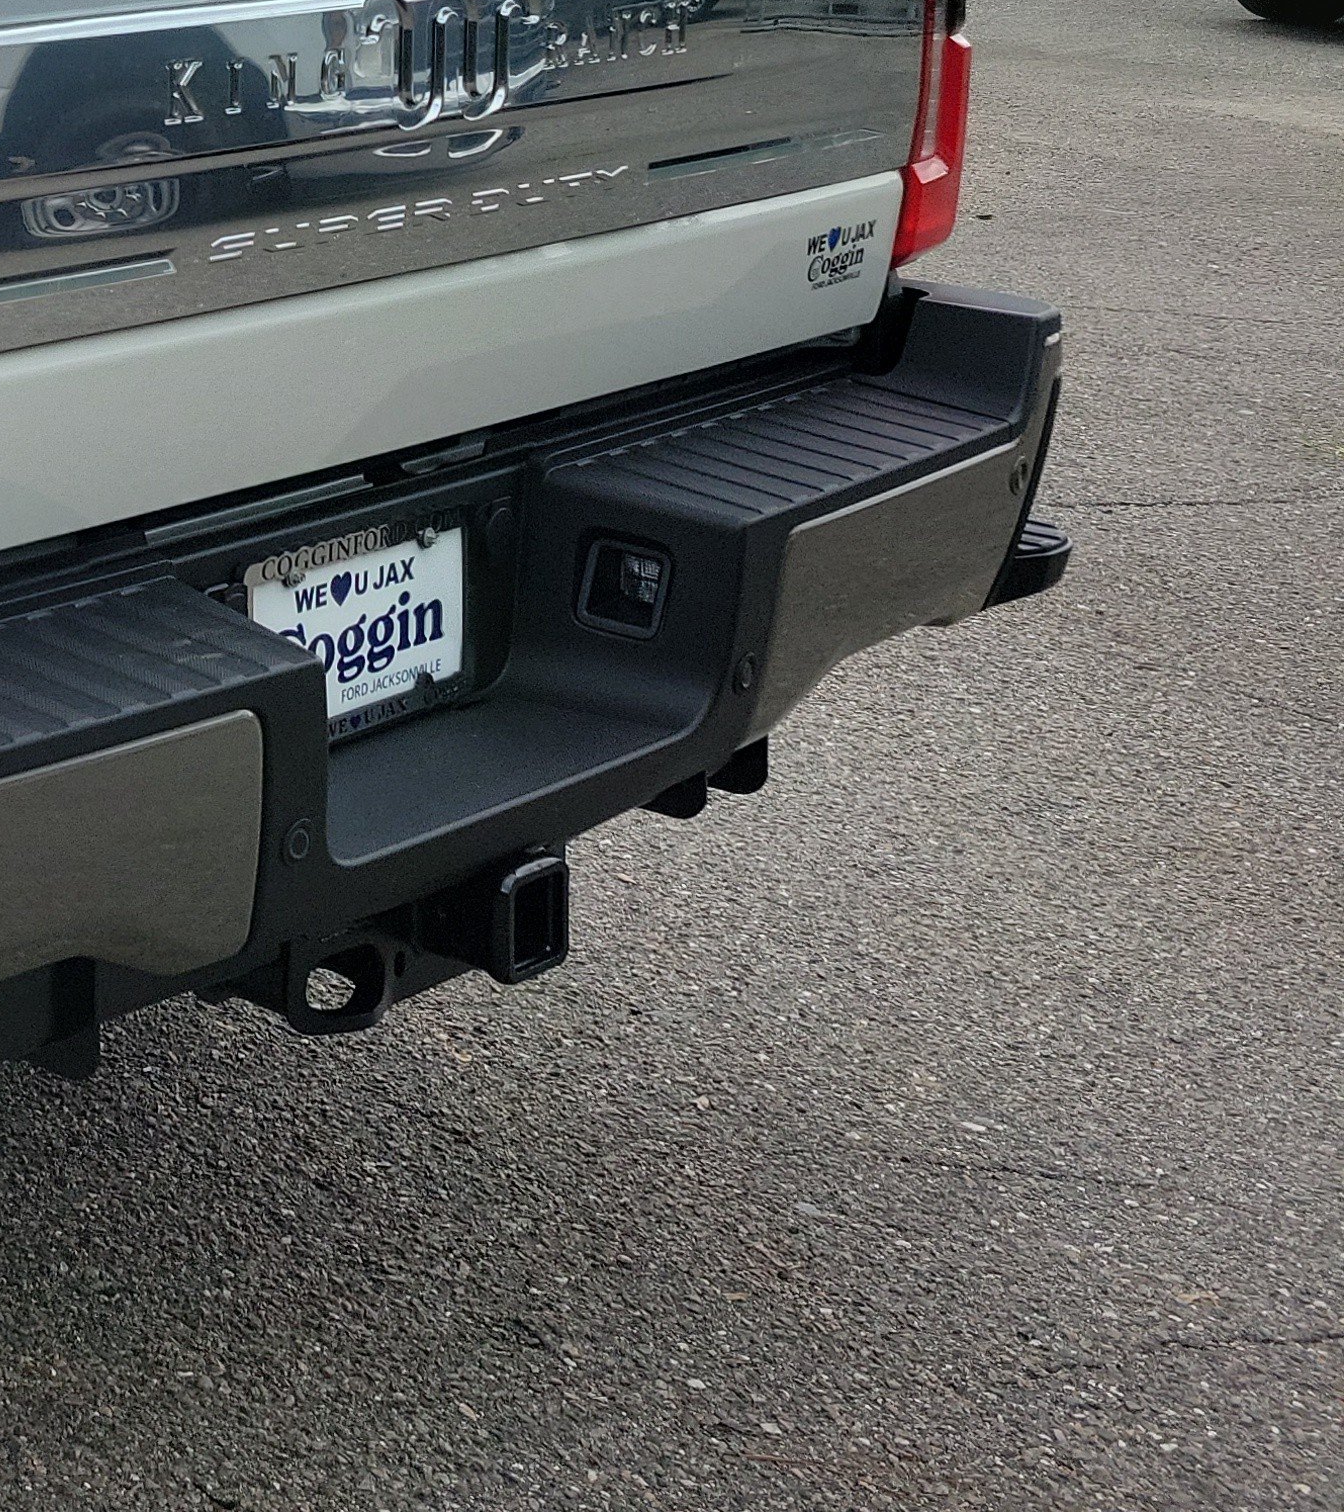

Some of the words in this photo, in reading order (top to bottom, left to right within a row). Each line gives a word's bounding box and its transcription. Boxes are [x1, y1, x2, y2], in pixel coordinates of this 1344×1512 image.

[163, 48, 347, 127] KING
[208, 196, 453, 262] SUPER
[471, 164, 629, 213] DUTY
[807, 234, 827, 256] WE
[851, 219, 877, 243] JAX
[807, 244, 865, 283] Coggin
[294, 581, 329, 614] WE
[354, 569, 369, 596] U
[373, 556, 416, 592] JAX
[340, 681, 370, 704] FORD
